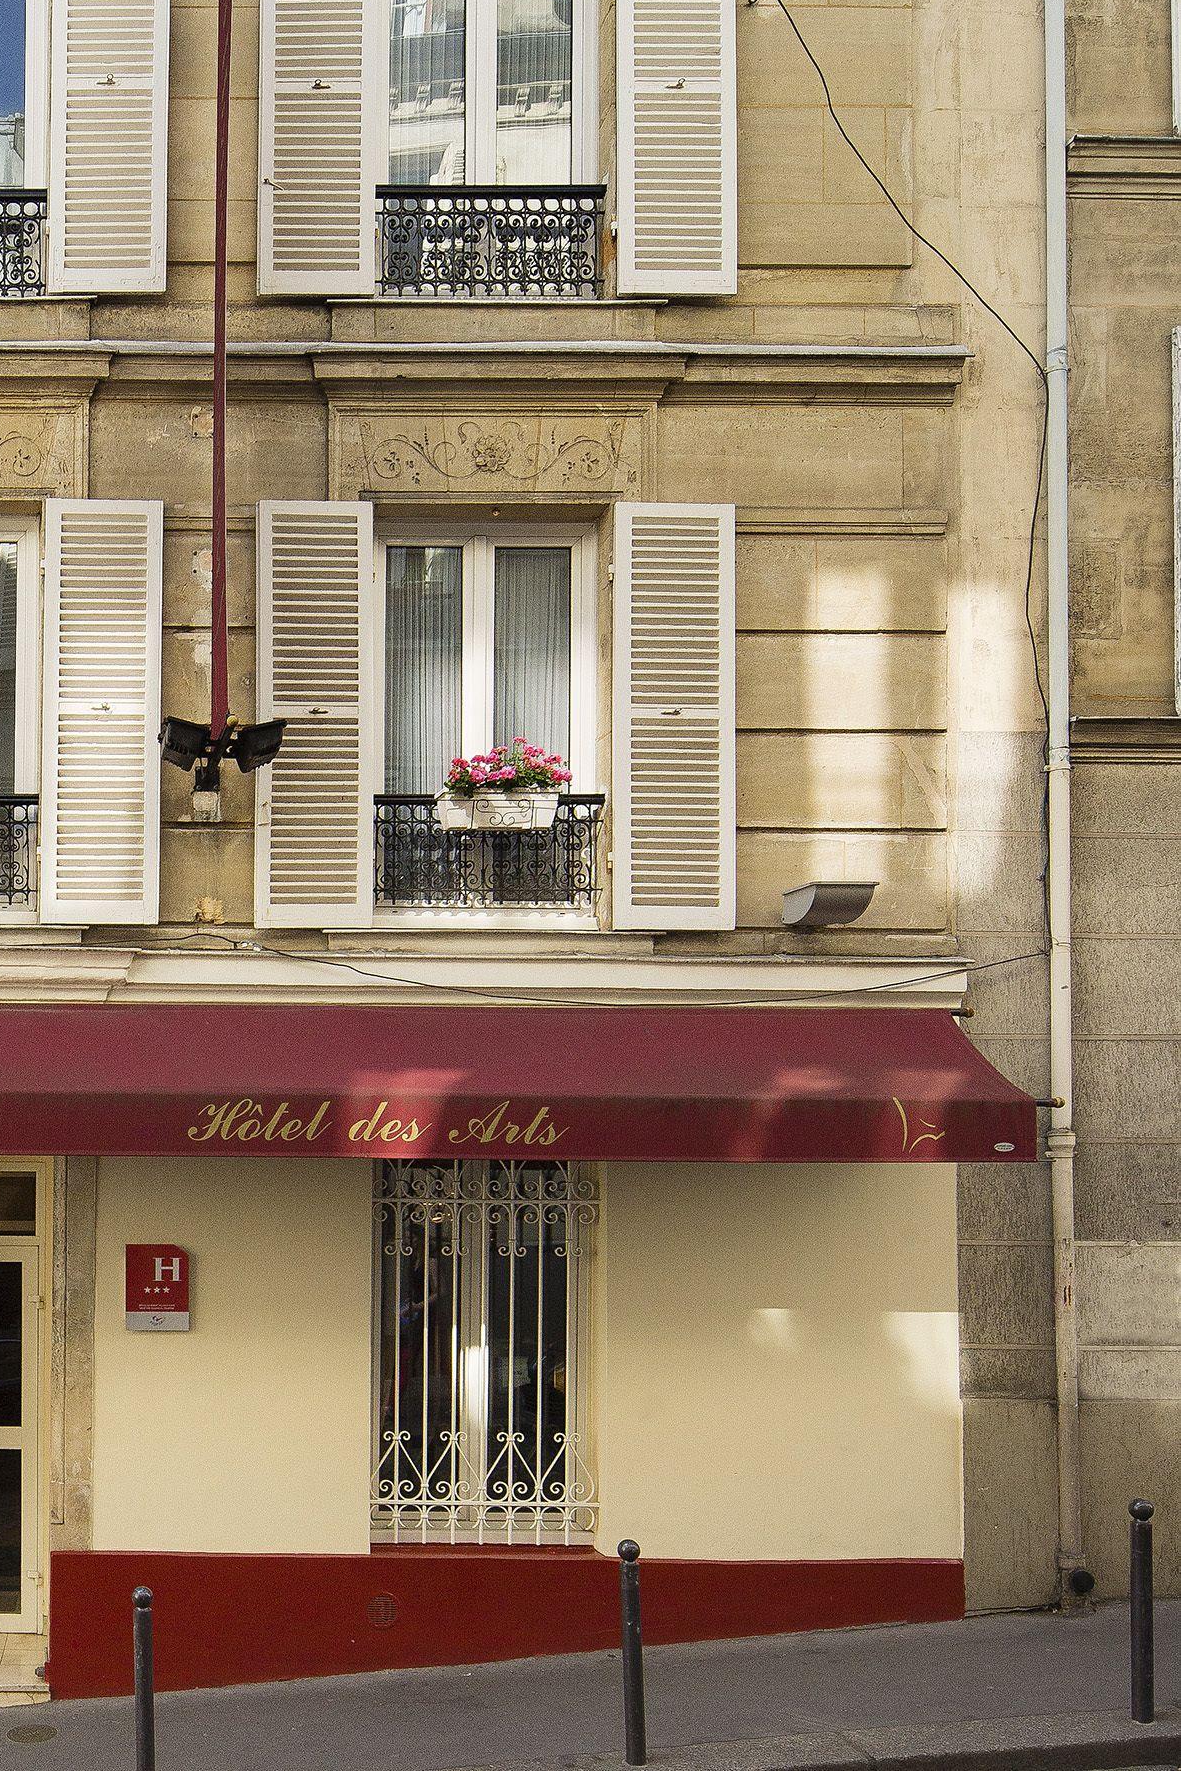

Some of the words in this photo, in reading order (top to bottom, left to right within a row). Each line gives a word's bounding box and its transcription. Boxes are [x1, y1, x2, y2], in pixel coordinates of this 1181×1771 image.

[187, 1098, 334, 1143] Hôtel
[348, 1101, 433, 1143] des
[449, 1100, 571, 1145] Arts
[152, 1257, 182, 1281] H
